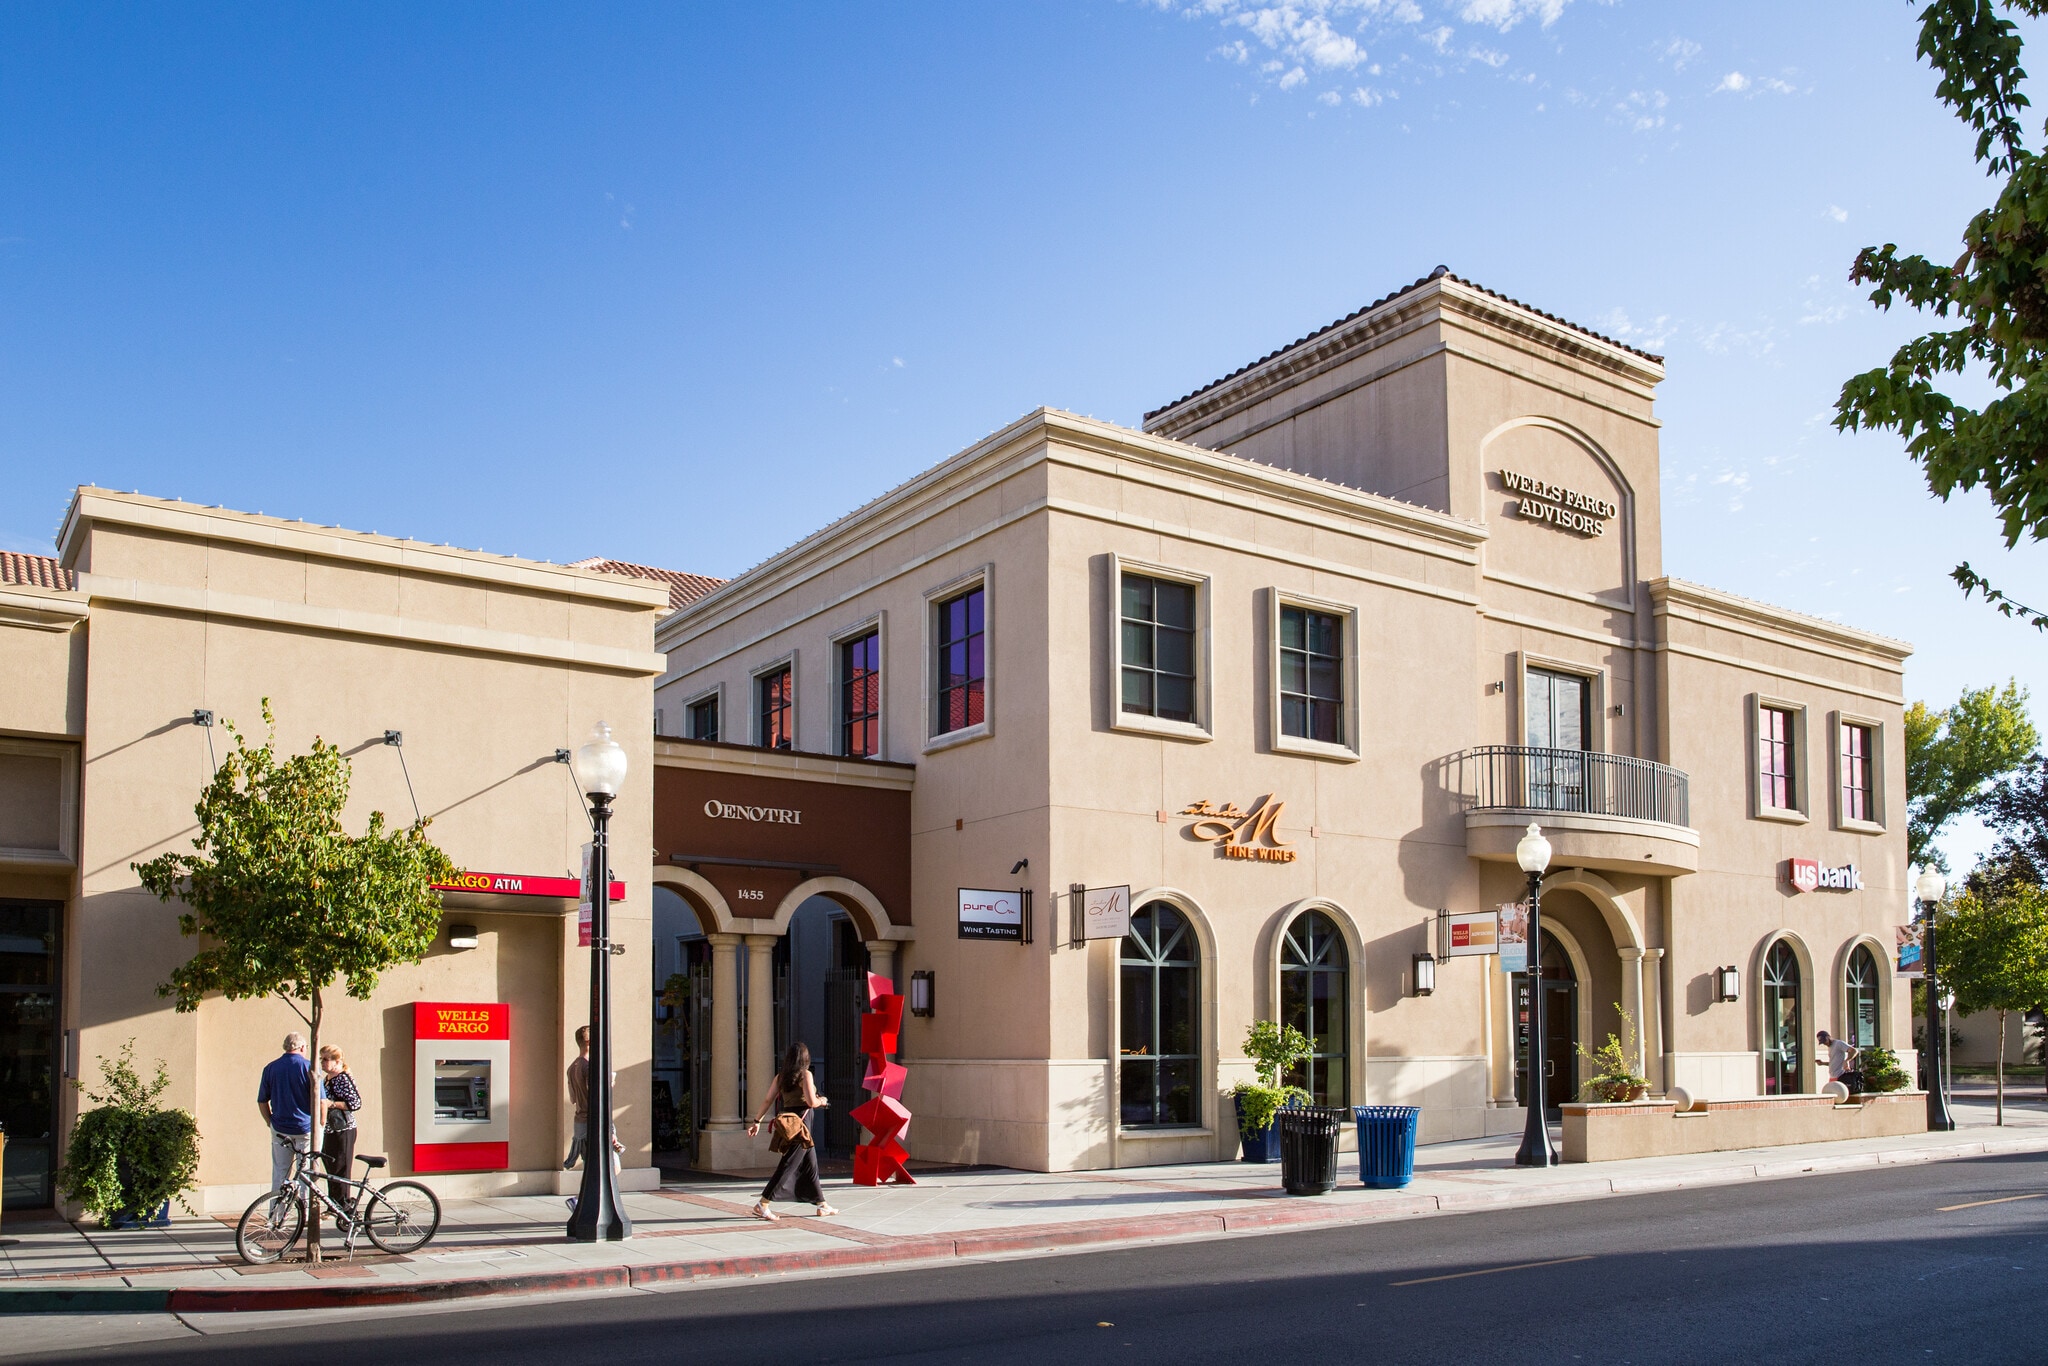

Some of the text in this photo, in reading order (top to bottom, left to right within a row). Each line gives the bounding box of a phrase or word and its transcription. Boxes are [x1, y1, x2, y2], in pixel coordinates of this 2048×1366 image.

[1500, 469, 1617, 519] WELLS FARGO
[1518, 498, 1604, 537] ADVISORS
[703, 799, 802, 825] OENOTRI
[1192, 793, 1297, 845] M
[1225, 845, 1297, 862] FINE WINES
[494, 877, 523, 891] ATM
[737, 889, 764, 901] 1455
[436, 1010, 490, 1022] WELLS
[437, 1022, 490, 1034] FARGO
